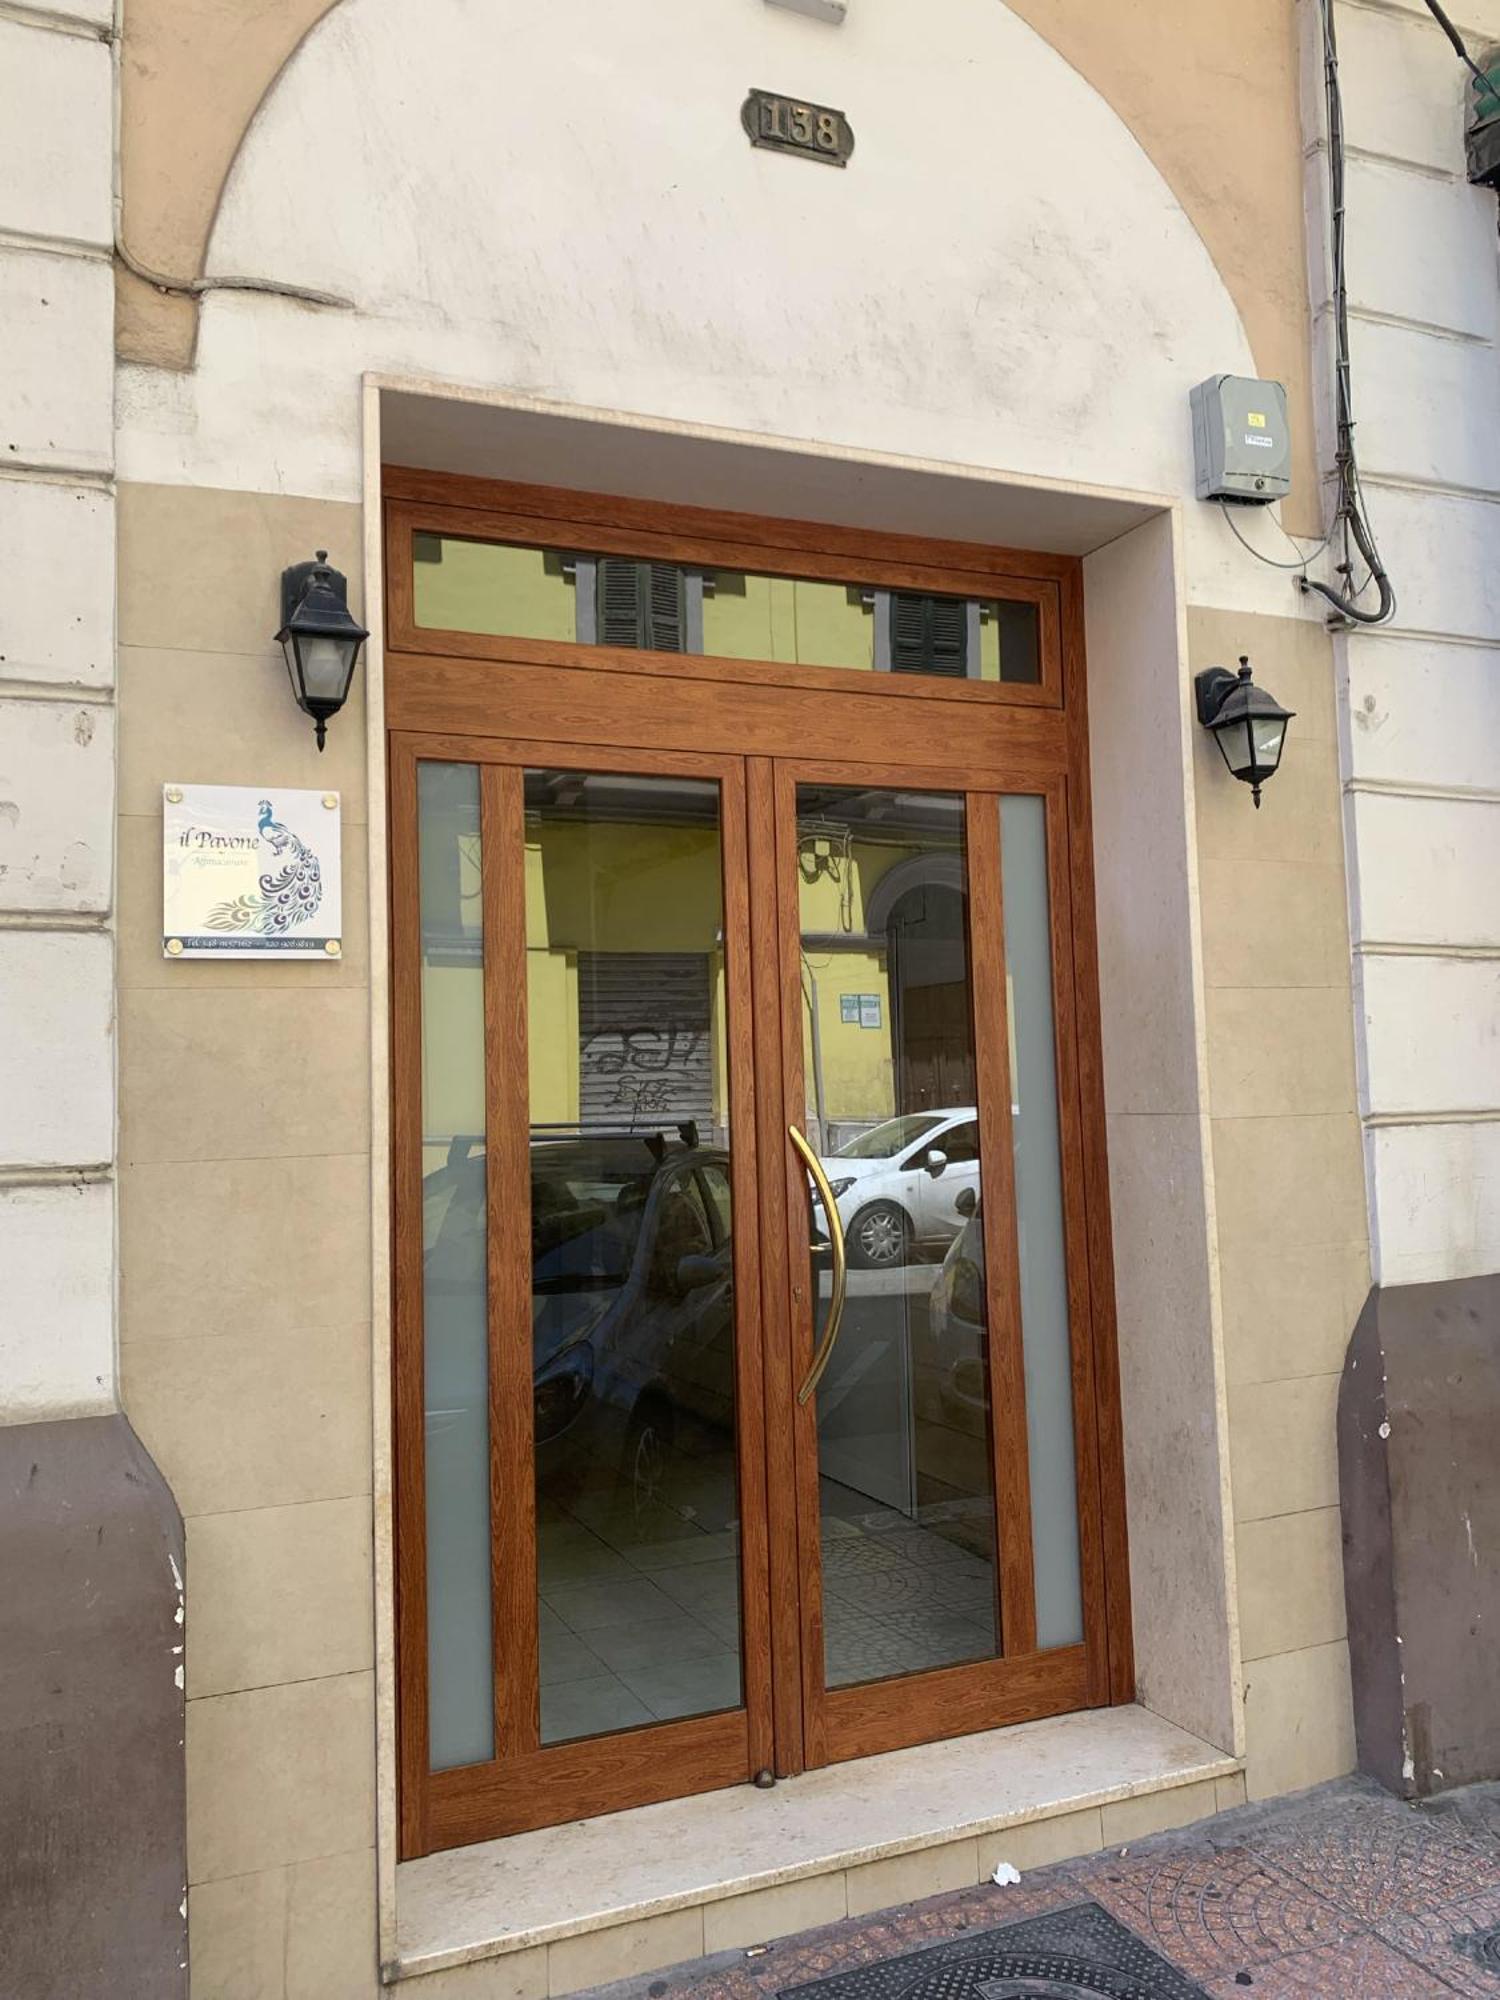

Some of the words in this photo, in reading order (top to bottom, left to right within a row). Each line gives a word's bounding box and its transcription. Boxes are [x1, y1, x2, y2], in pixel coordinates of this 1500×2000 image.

[765, 99, 839, 150] 138
[179, 827, 196, 847] il
[195, 831, 260, 850] Pavone
